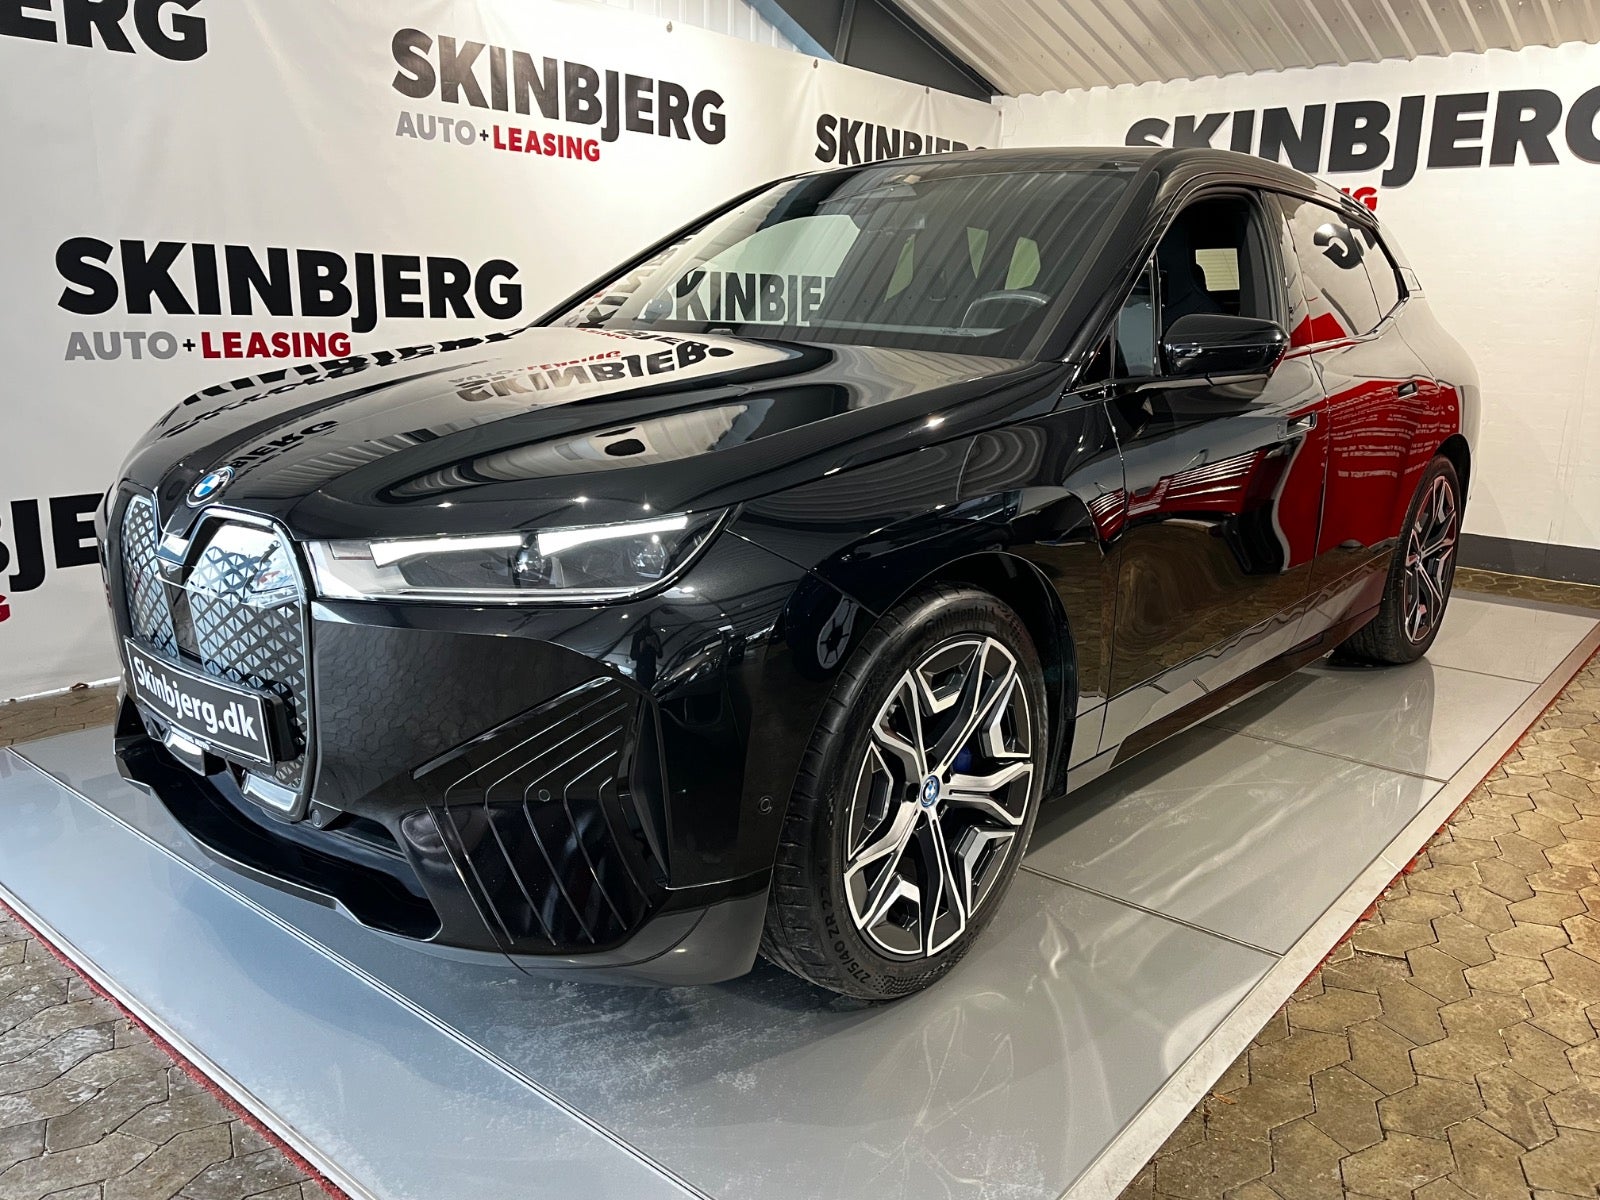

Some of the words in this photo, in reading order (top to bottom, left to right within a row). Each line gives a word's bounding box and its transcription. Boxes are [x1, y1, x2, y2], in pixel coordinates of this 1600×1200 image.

[391, 28, 726, 144] SKINBJERG
[395, 111, 475, 146] AUTO
[493, 126, 601, 162] LEASING
[55, 236, 522, 332] SKINBJERG
[65, 331, 178, 361] AUTO
[201, 331, 352, 359] LEASING
[0, 492, 104, 592] JE
[133, 656, 259, 741] Skinbjerg.dk
